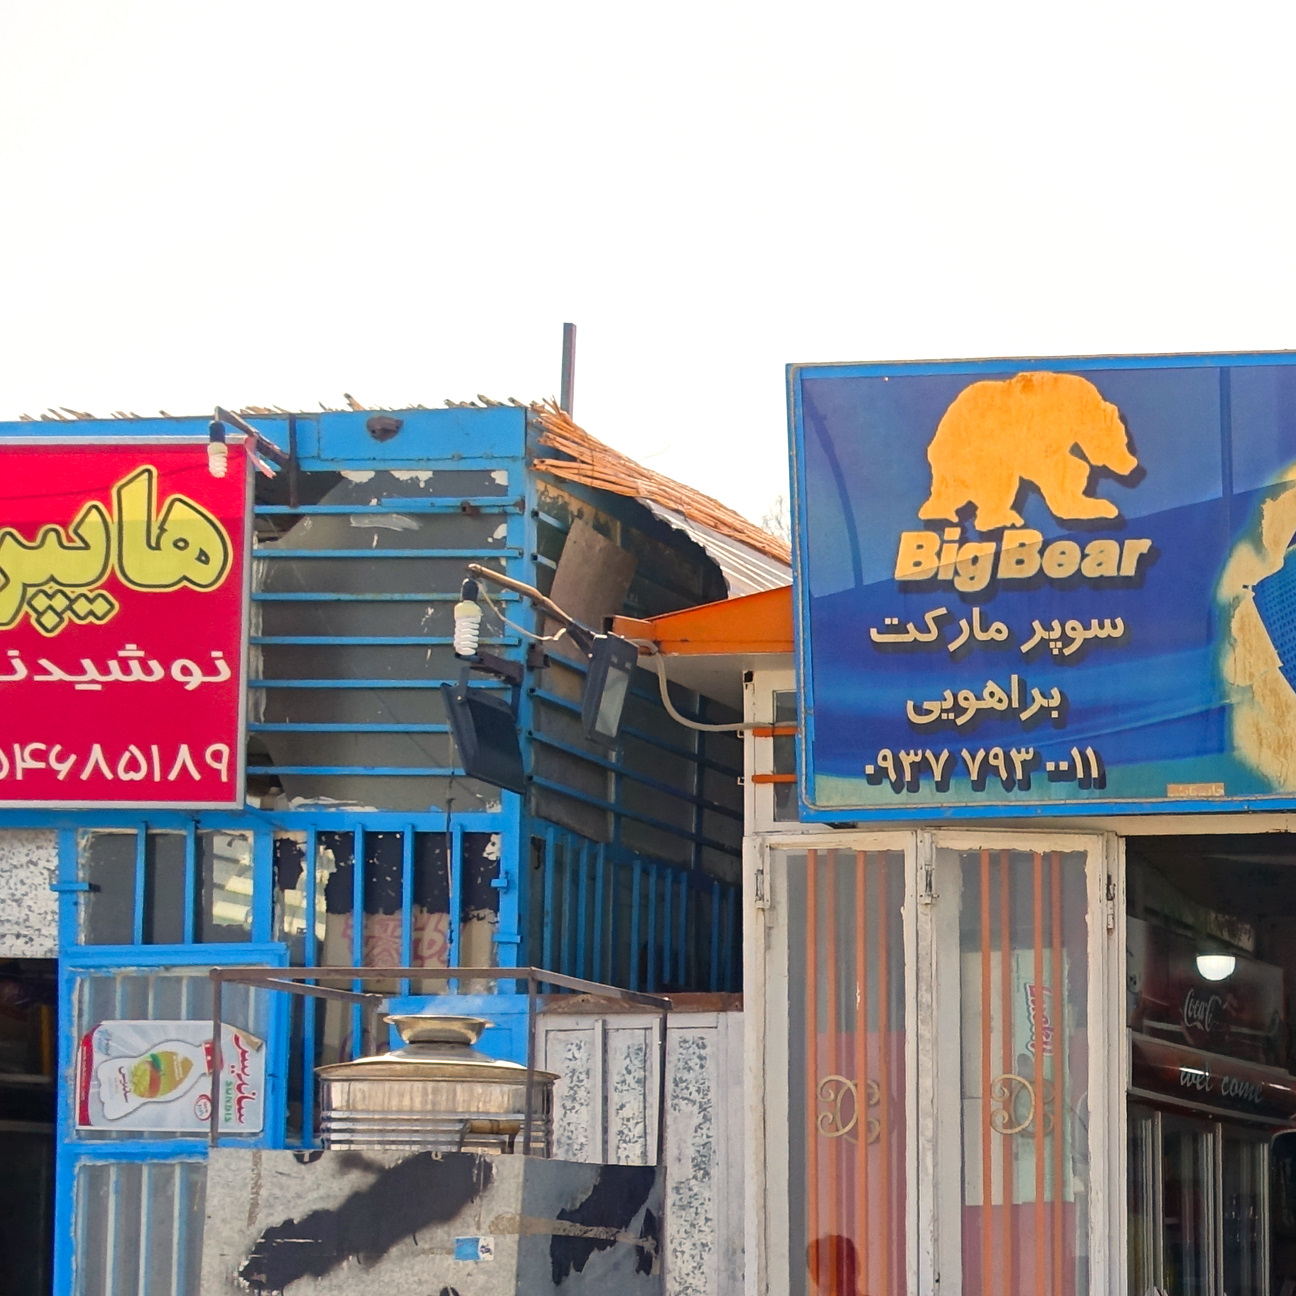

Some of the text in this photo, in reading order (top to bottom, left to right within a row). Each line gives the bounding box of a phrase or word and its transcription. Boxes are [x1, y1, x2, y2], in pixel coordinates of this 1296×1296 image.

[869, 607, 1125, 656] سوپر مارکت
[0, 644, 231, 691] نوشیدن
[906, 674, 1061, 726] براهویی
